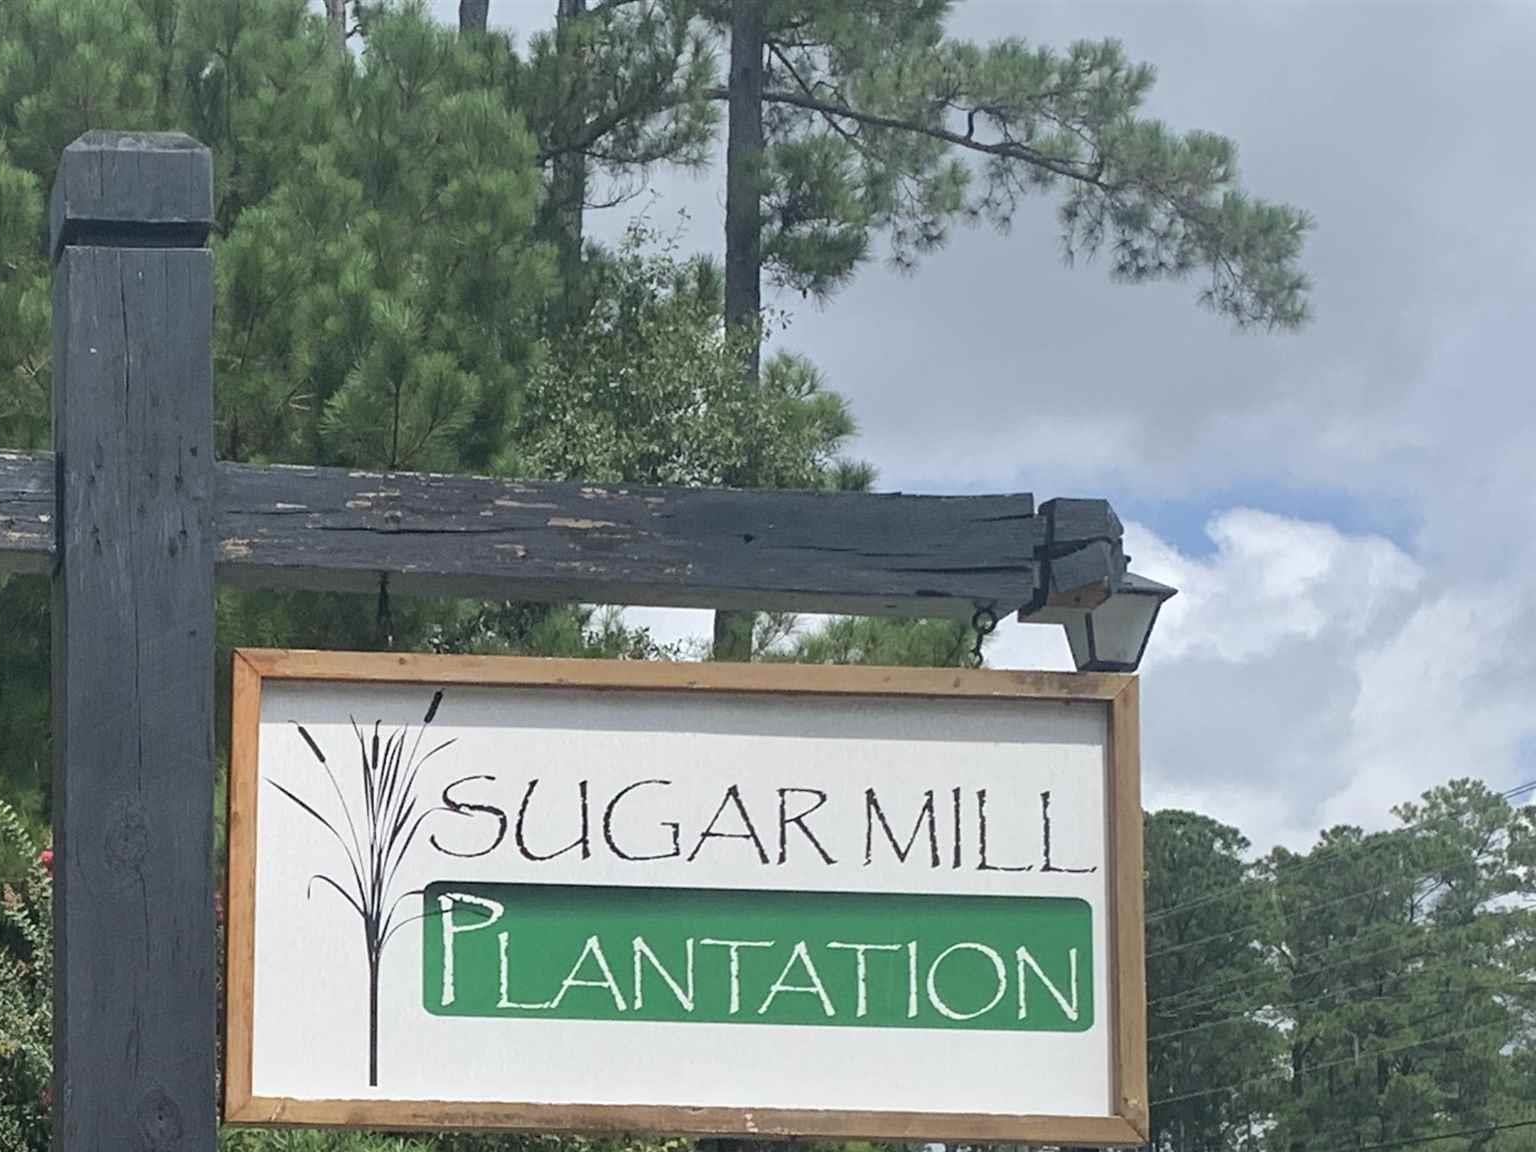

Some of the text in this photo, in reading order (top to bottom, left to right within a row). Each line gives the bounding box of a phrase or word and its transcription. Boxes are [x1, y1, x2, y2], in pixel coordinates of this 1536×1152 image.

[430, 776, 1099, 875] SUGAR MILL
[437, 892, 1080, 1023] PLANTATION
